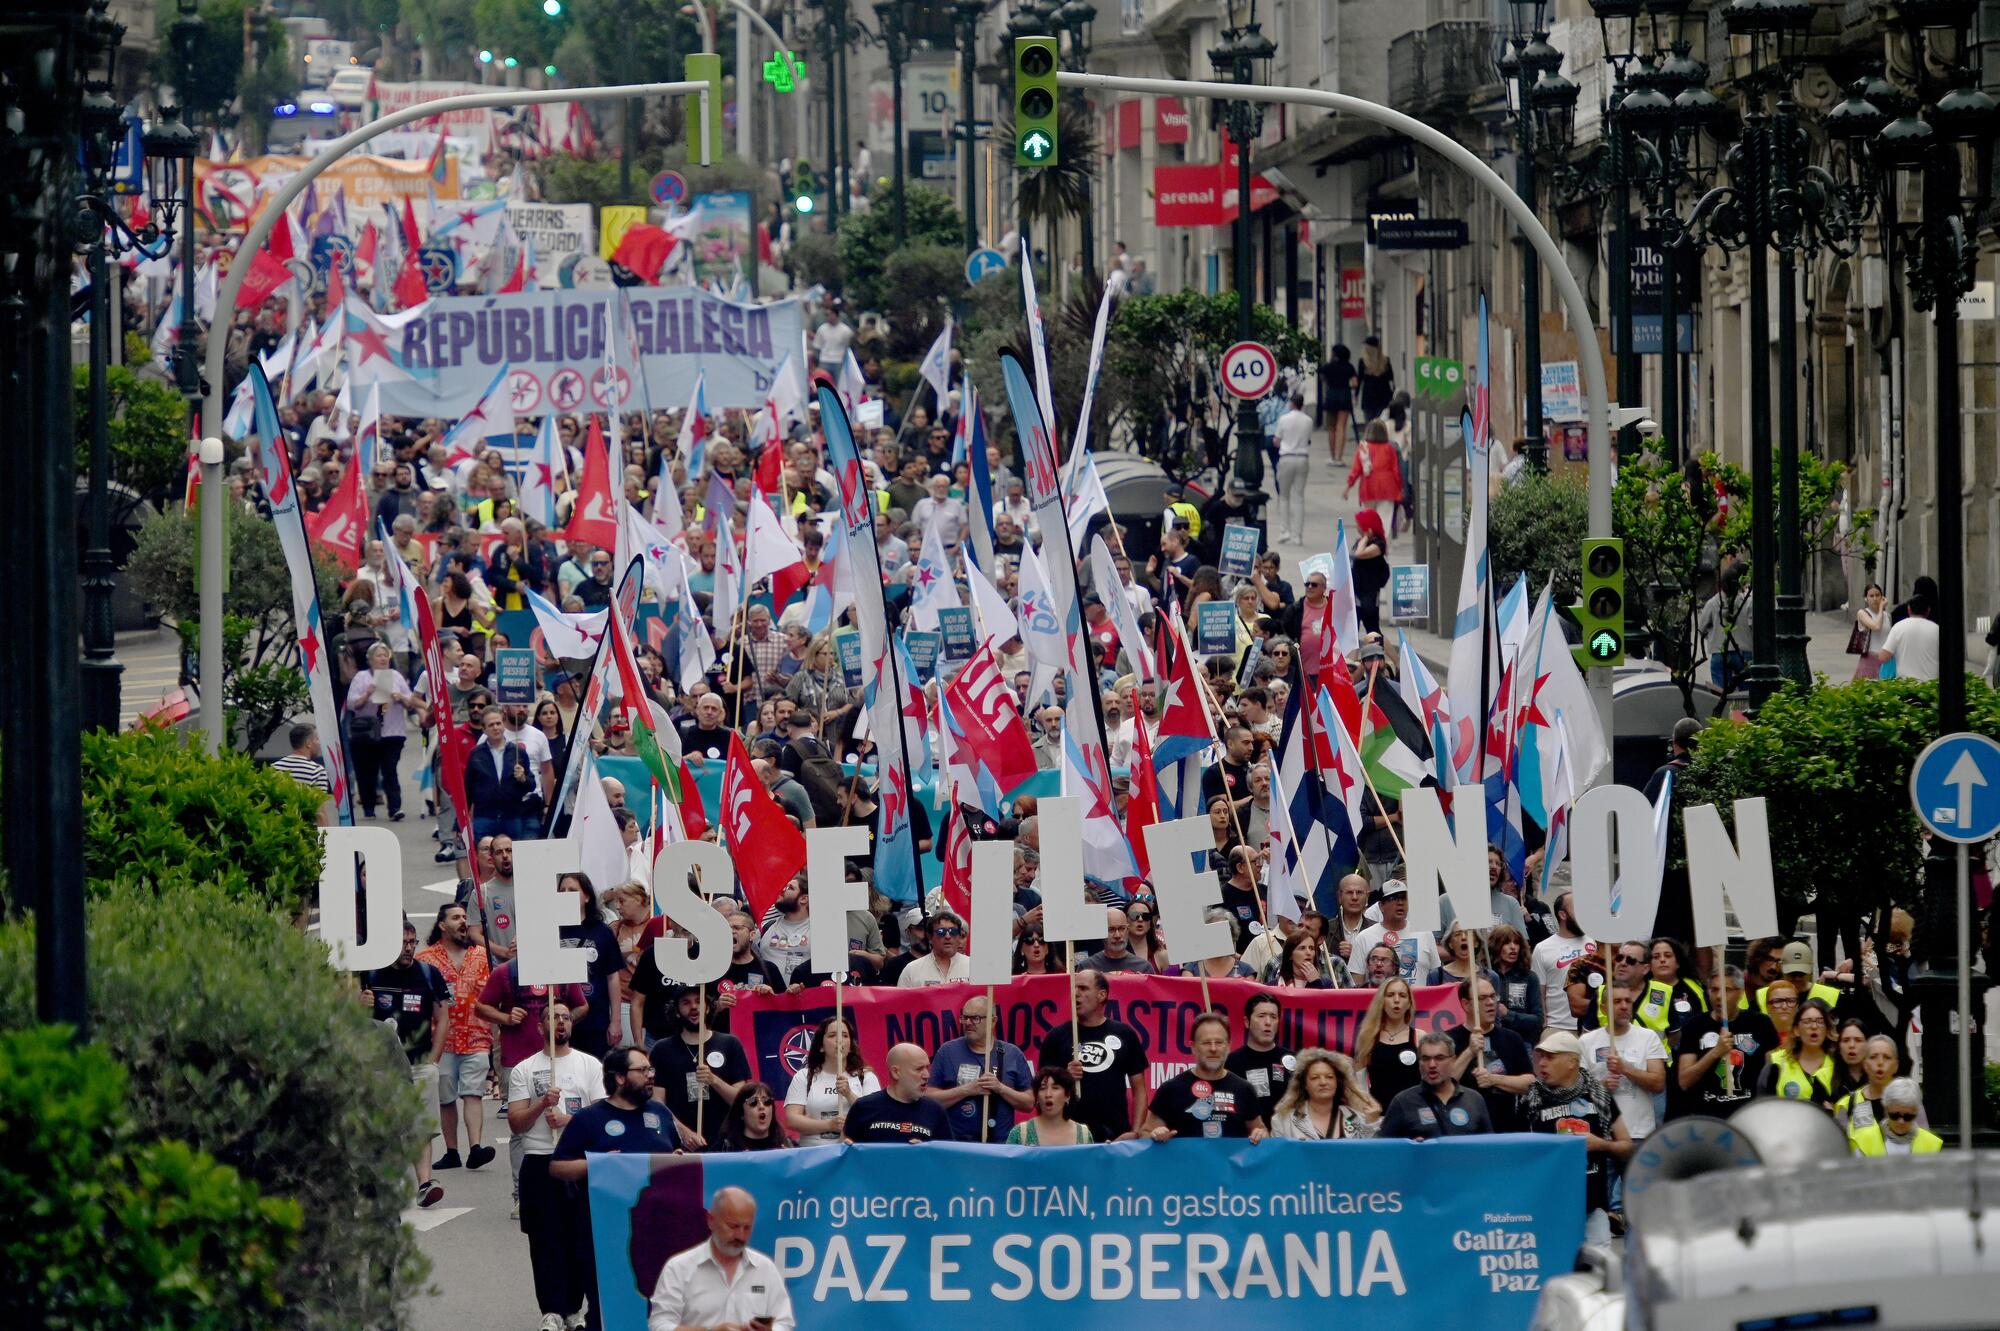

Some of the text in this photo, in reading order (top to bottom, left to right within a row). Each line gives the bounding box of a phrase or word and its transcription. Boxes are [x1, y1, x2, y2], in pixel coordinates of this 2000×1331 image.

[1160, 188, 1215, 205] arenal
[402, 298, 774, 369] REPÚBLICA GALEGA
[1232, 360, 1264, 379] 40
[777, 1182, 1403, 1228] nin guerra, nin OTAN, nin gastos militares
[1484, 1213, 1533, 1223] Plataforma
[1453, 1228, 1537, 1251] Galiza
[773, 1229, 1407, 1302] PAZ E SOBERANIA
[1479, 1250, 1539, 1276] pola
[1490, 1272, 1541, 1292] Paz
